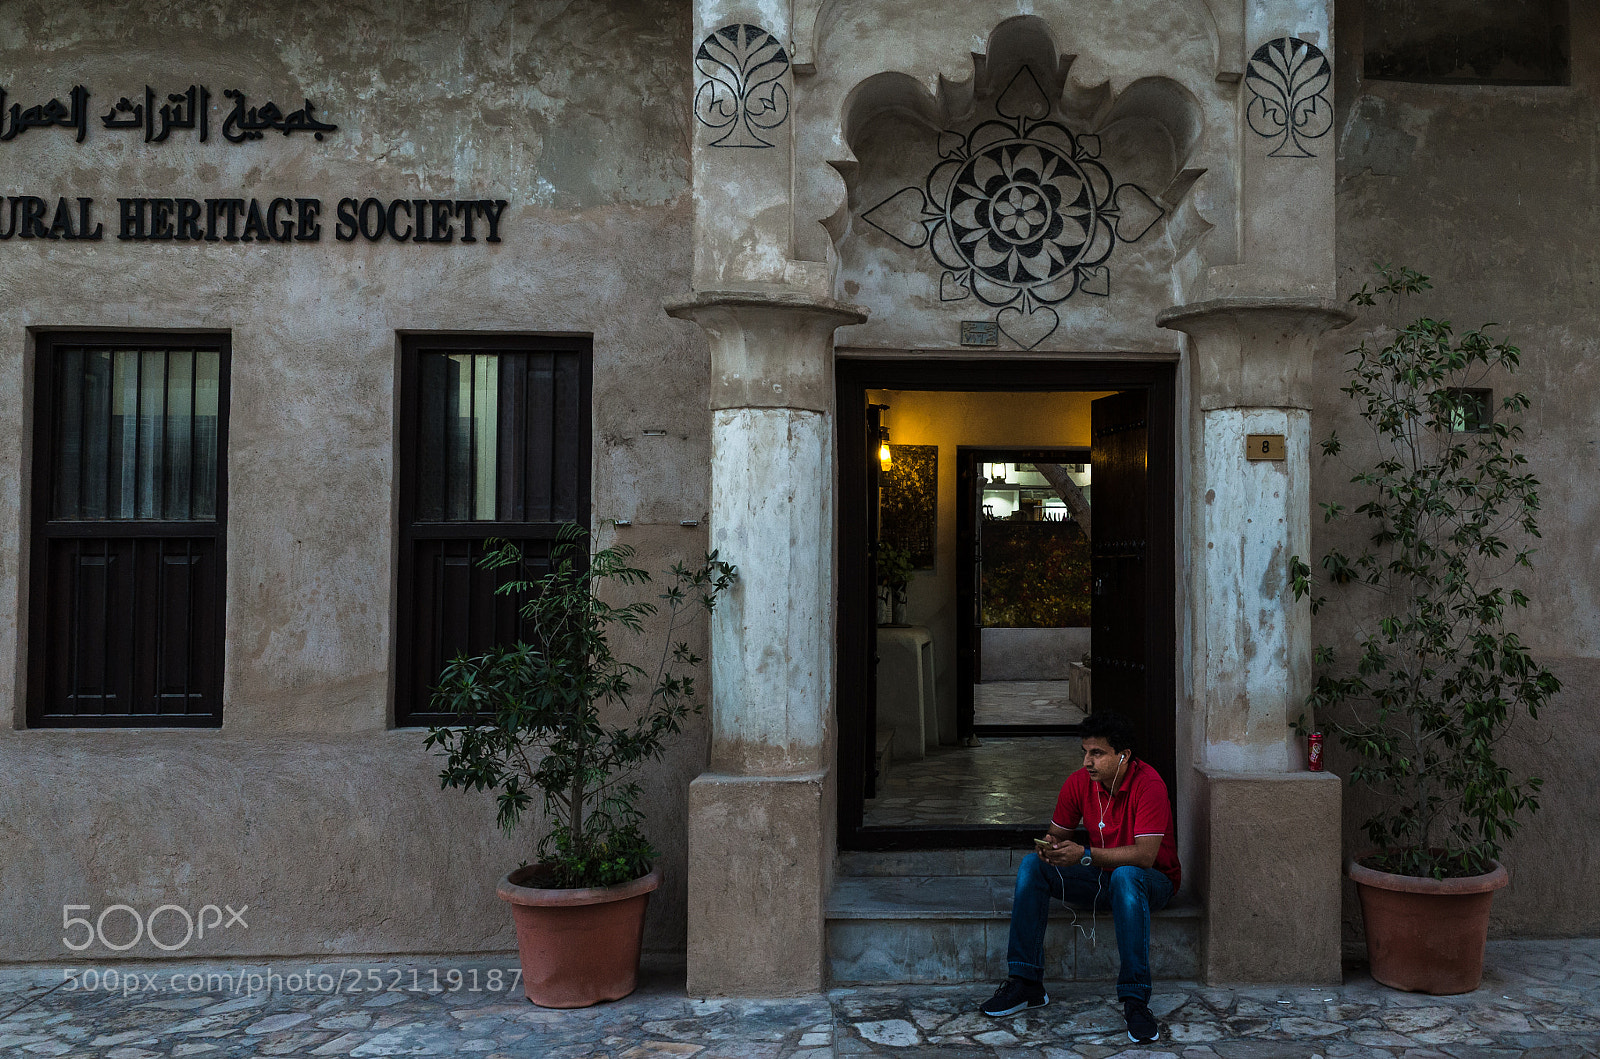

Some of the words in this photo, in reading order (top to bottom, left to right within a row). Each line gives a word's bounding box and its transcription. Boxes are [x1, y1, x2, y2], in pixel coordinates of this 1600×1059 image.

[101, 84, 212, 144] التراث
[222, 88, 338, 144] جمعية
[117, 197, 321, 244] HERITAGE
[336, 197, 508, 245] SOCIETY
[1262, 440, 1270, 453] 8
